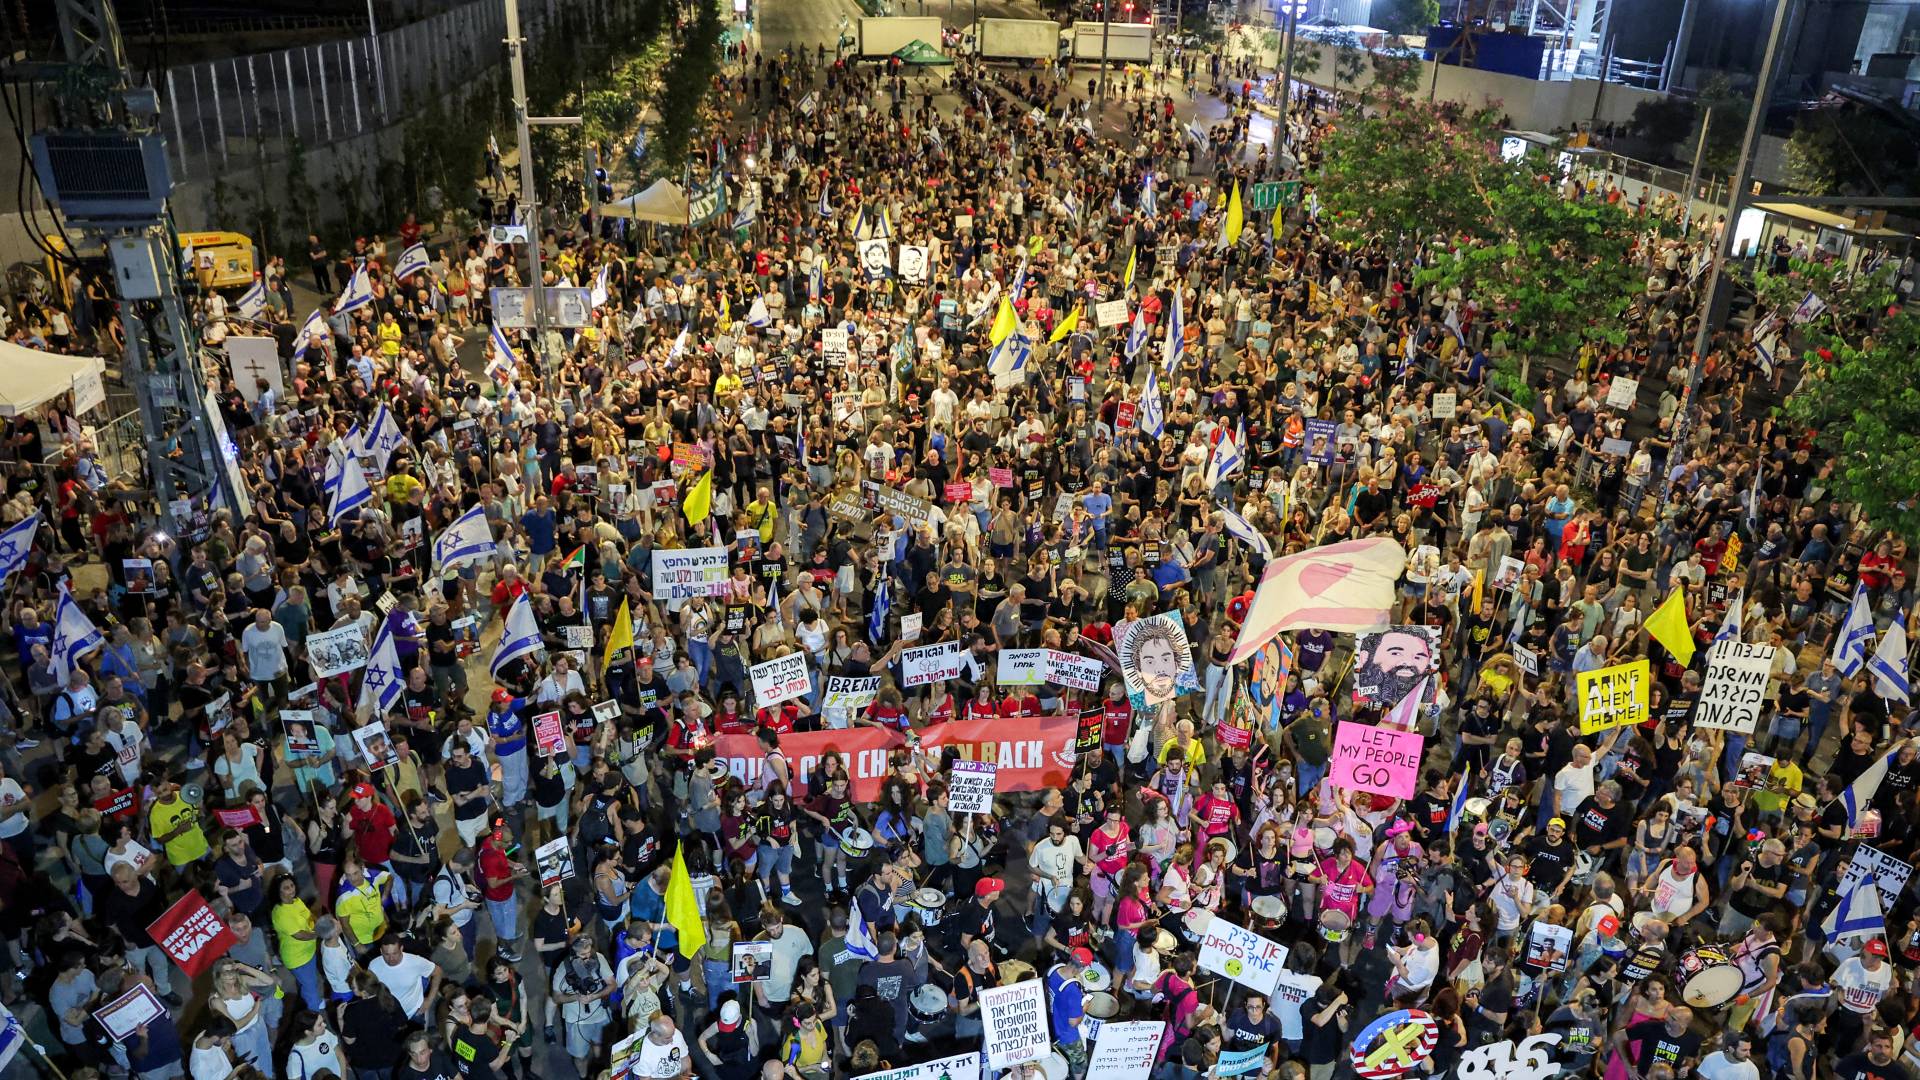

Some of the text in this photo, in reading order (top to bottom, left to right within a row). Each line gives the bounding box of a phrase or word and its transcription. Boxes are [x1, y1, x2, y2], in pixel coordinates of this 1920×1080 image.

[831, 501, 866, 521] החטופים
[878, 495, 929, 520] החטופים
[663, 555, 728, 569] מי האיש החפץ
[671, 584, 692, 598] שלום
[781, 655, 803, 671] אומרים
[904, 643, 958, 663] מי הבא בתור
[906, 667, 958, 686] ומי בתור הבא
[1054, 668, 1098, 682] MORAL CALL
[1068, 664, 1082, 673] THE
[1084, 667, 1101, 677] ONLY
[1709, 665, 1765, 686] ממשלה
[763, 685, 783, 699] לבד
[829, 677, 881, 693] BREAK
[1066, 677, 1084, 687] THEM
[1085, 681, 1098, 691] ALL
[1589, 691, 1634, 707] THEM
[1706, 684, 1760, 705] בוגדת
[1592, 705, 1641, 727] HOME!
[1697, 701, 1753, 727] בעמה
[1361, 729, 1402, 748] LET
[1340, 744, 1418, 769] MY PEOPLE
[1353, 764, 1390, 788] GO
[1858, 844, 1912, 875] היום זה
[1875, 863, 1907, 883] איימן
[162, 905, 209, 948] END THIS
[174, 921, 224, 962] WAR
[1228, 927, 1281, 959] אין צדיק
[1205, 934, 1274, 972] אחד בסדום
[985, 985, 1038, 1007] די למלחמה!
[1278, 984, 1308, 998] בחירות
[991, 998, 1037, 1018] החזירו את
[993, 1010, 1037, 1030] החטופים!
[996, 1022, 1038, 1041] צאו מעזה
[991, 1032, 1047, 1055] וצא לנבצרות
[927, 1062, 951, 1073] ציד
[956, 1057, 973, 1068] זה
